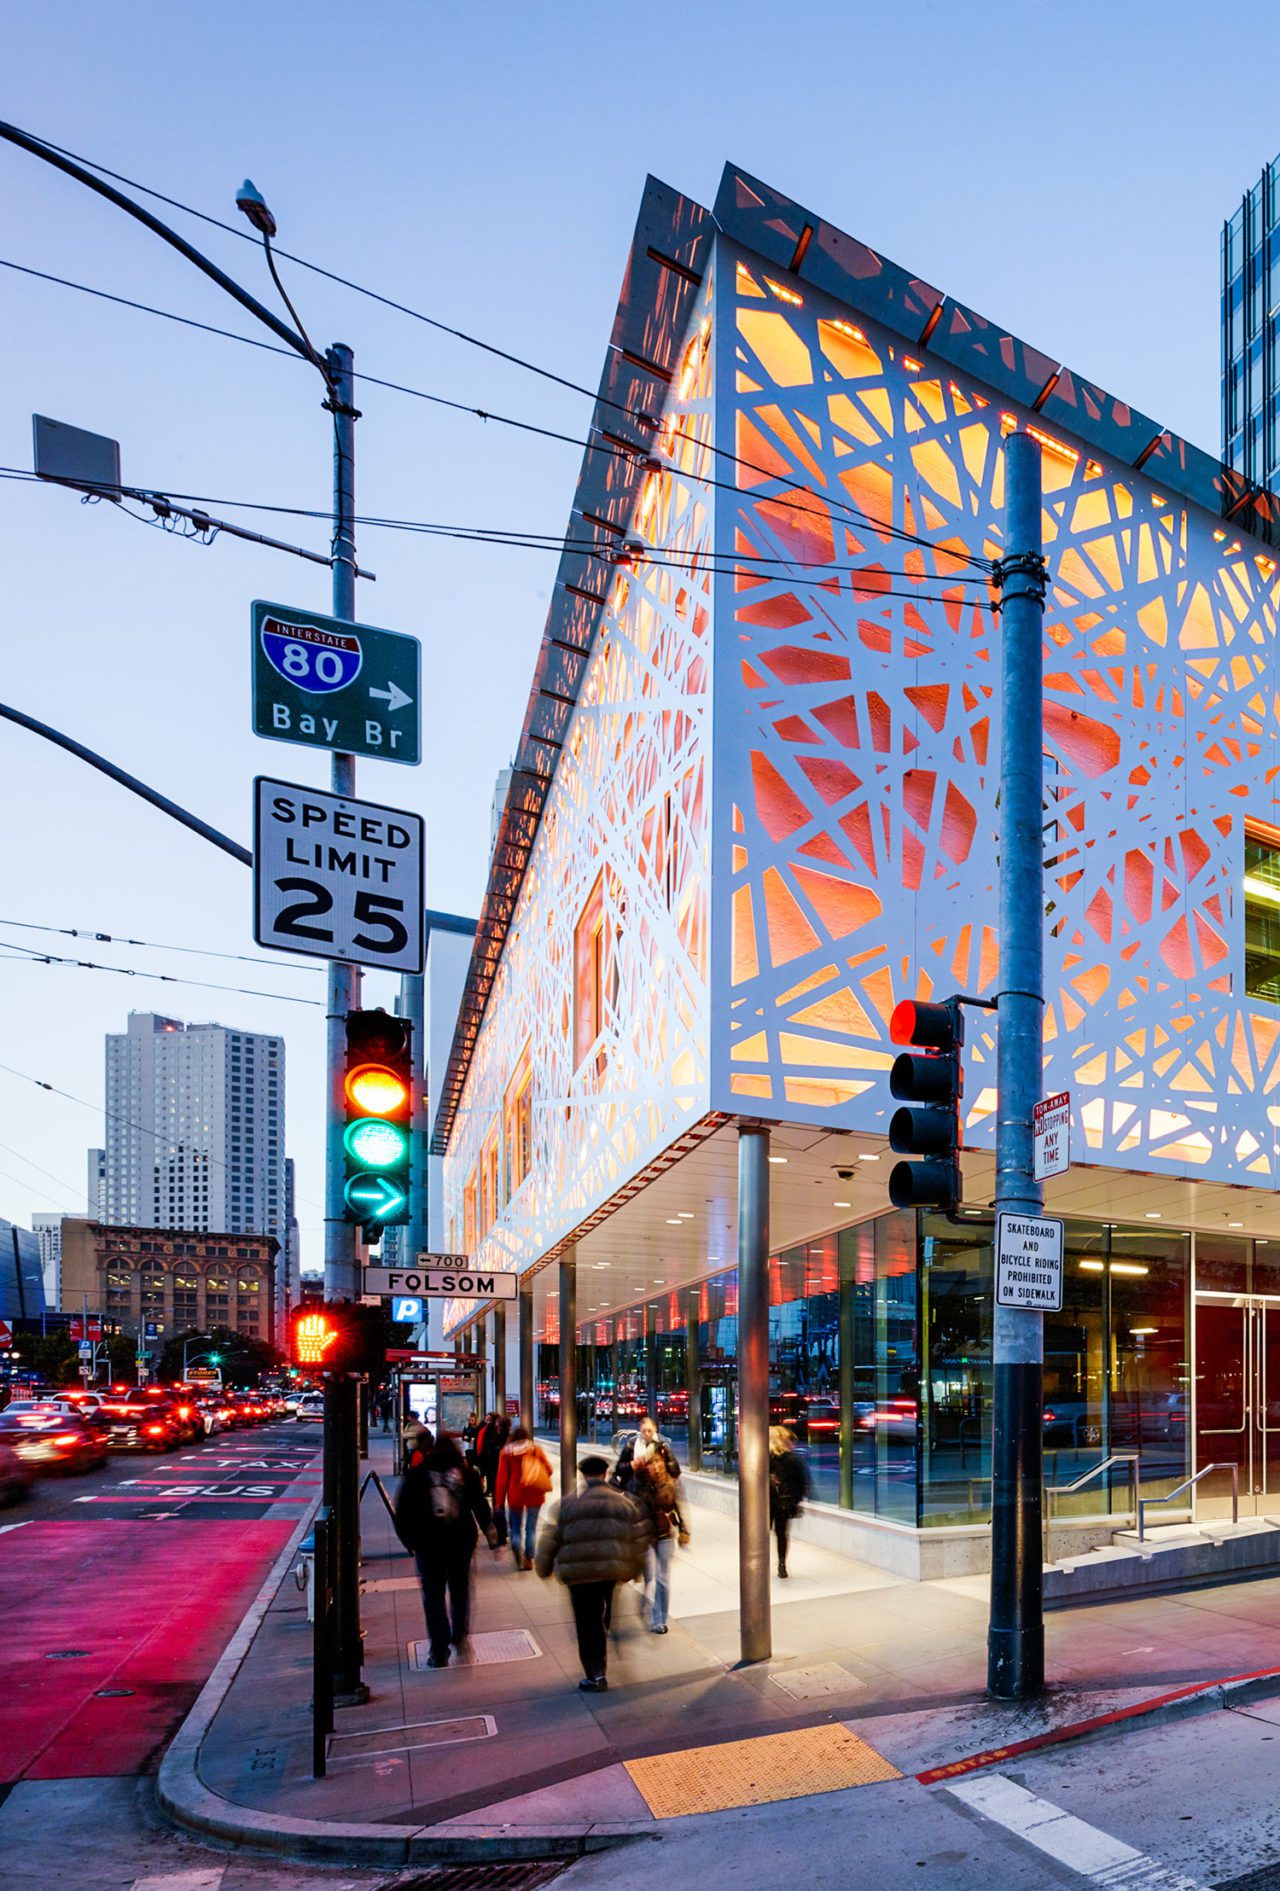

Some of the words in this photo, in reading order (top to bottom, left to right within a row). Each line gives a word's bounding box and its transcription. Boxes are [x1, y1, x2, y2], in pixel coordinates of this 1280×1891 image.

[276, 624, 347, 648] INTERSTATE
[282, 643, 343, 684] 80
[273, 703, 339, 742] Bay
[365, 720, 403, 748] Br
[271, 797, 411, 849] SPEED
[286, 837, 396, 883] LIMIT
[272, 877, 409, 954] 25
[1035, 1094, 1068, 1116] TOW-AWAY
[1034, 1116, 1044, 1136] NO
[1044, 1110, 1068, 1132] STOPPING
[1044, 1131, 1059, 1149] ANY
[1043, 1147, 1059, 1165] TIME
[1007, 1222, 1055, 1239] SKATEBOARD
[1022, 1240, 1039, 1252] AND
[434, 1256, 463, 1267] 700
[1001, 1254, 1031, 1267] BICYCLE
[1034, 1257, 1059, 1270] RIDING
[388, 1273, 495, 1293] FOLSOM
[1007, 1270, 1052, 1285] PROHIBITED
[1003, 1286, 1014, 1297] ON
[1017, 1287, 1056, 1300] SIDEWALK
[396, 1300, 419, 1321] P
[216, 1460, 312, 1469] TAXI
[158, 1485, 276, 1497] BUS
